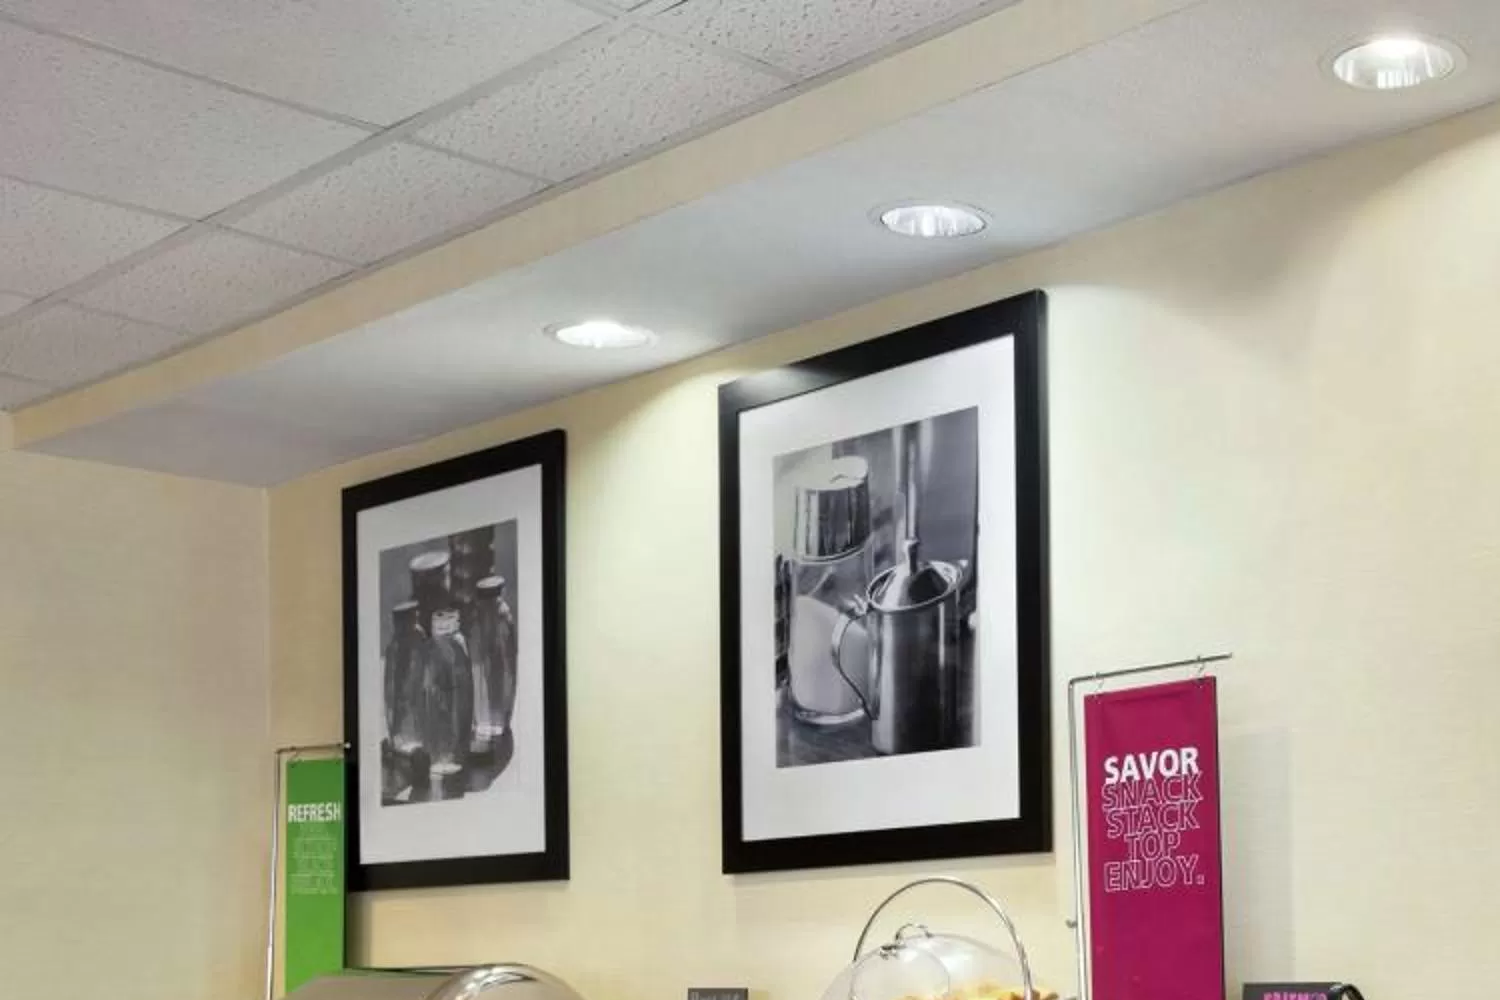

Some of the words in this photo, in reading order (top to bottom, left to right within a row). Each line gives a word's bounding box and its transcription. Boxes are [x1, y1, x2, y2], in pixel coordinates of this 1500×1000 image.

[1104, 747, 1200, 785] SAVOR
[1102, 771, 1204, 813] SNACK
[287, 801, 341, 823] REFRESH
[1106, 800, 1201, 839] STACK
[1124, 831, 1182, 862] TOP
[1104, 854, 1206, 893] ENJOY.
